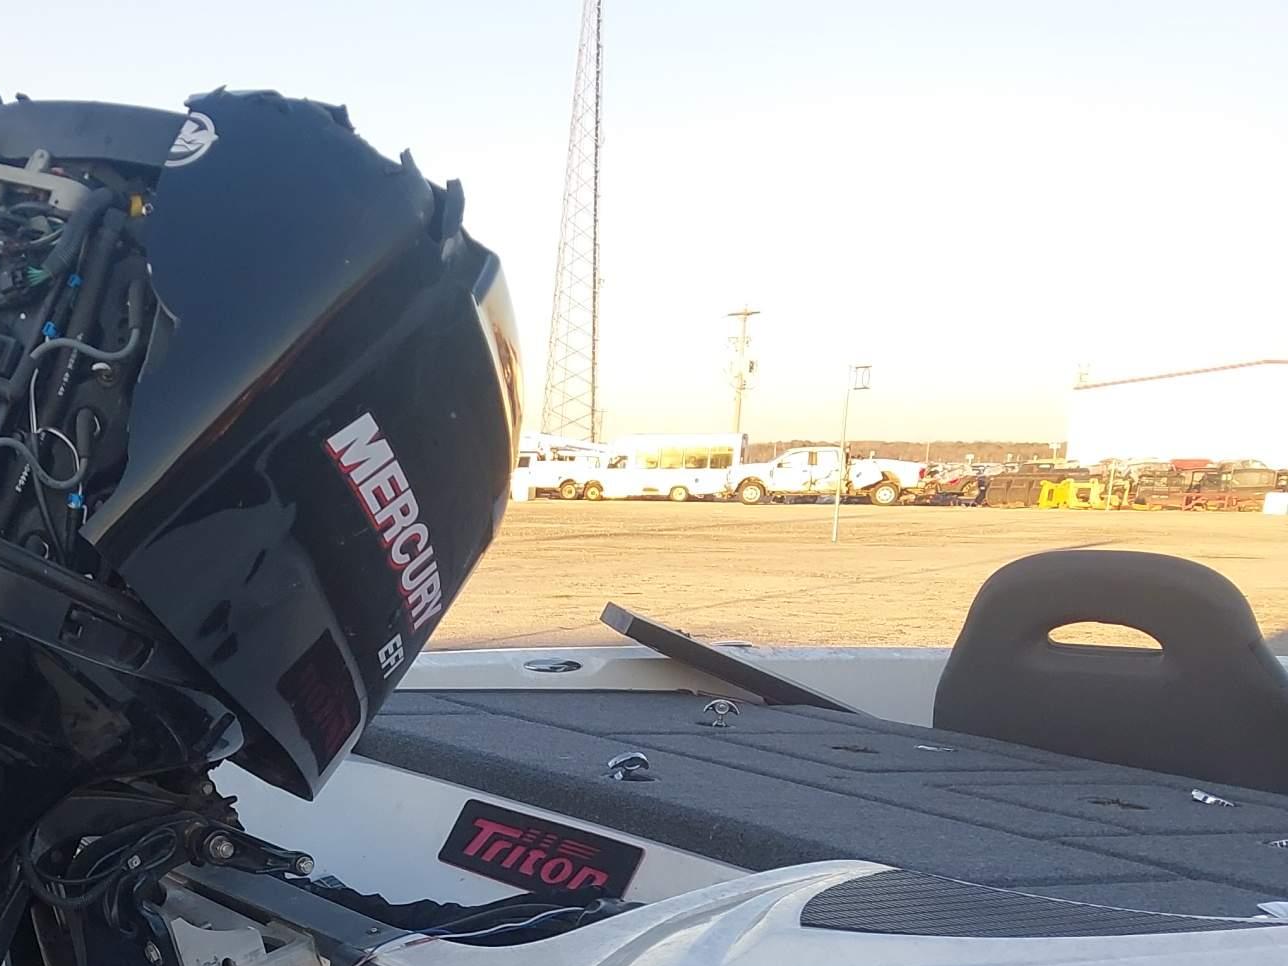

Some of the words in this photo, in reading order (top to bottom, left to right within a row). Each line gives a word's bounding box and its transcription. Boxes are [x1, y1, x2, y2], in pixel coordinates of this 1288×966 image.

[324, 411, 443, 632] MERCURY
[378, 633, 406, 680] EFI
[463, 817, 609, 890] Triton
